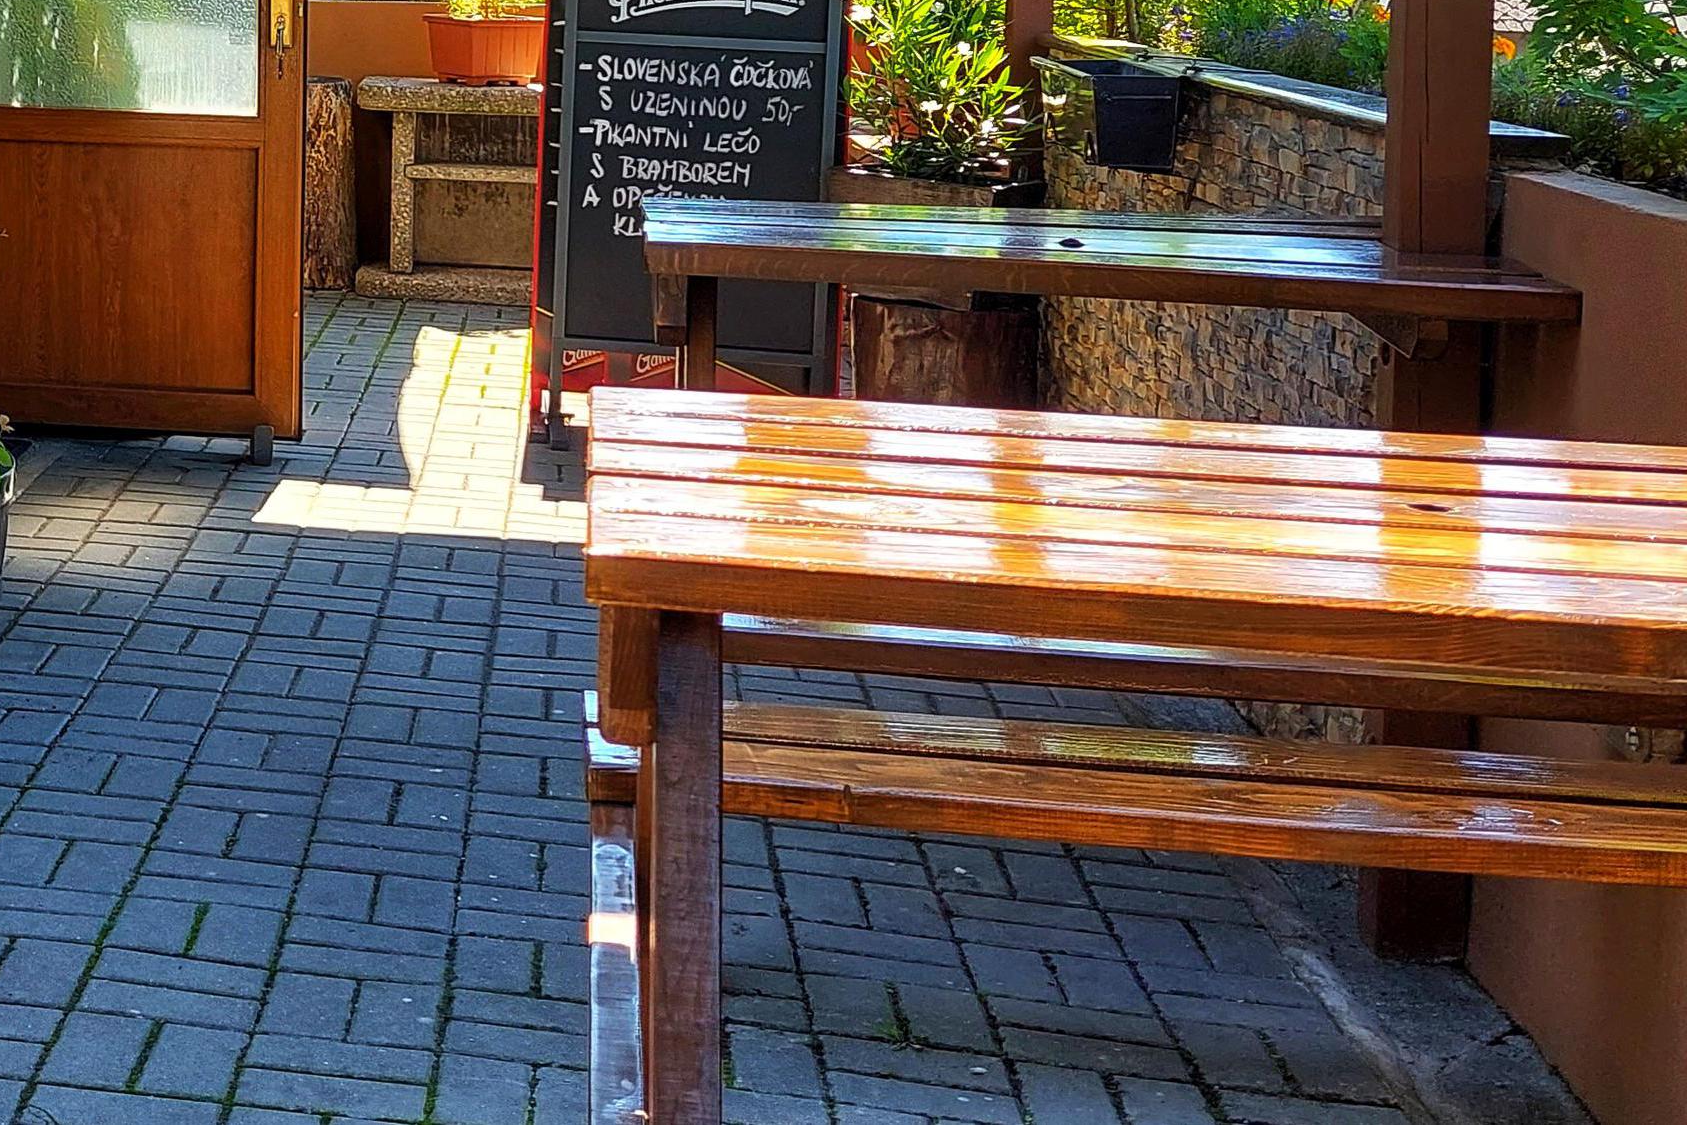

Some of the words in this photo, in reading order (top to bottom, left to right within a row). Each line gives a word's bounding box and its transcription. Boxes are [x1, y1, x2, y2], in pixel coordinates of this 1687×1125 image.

[729, 55, 814, 90] ČOČKOVÁ
[598, 85, 613, 111] S
[630, 89, 747, 120] UZENINOU
[703, 127, 761, 153] LEČO
[590, 152, 605, 179] S
[618, 155, 751, 187] BRAMBOREM
[582, 183, 601, 208] A
